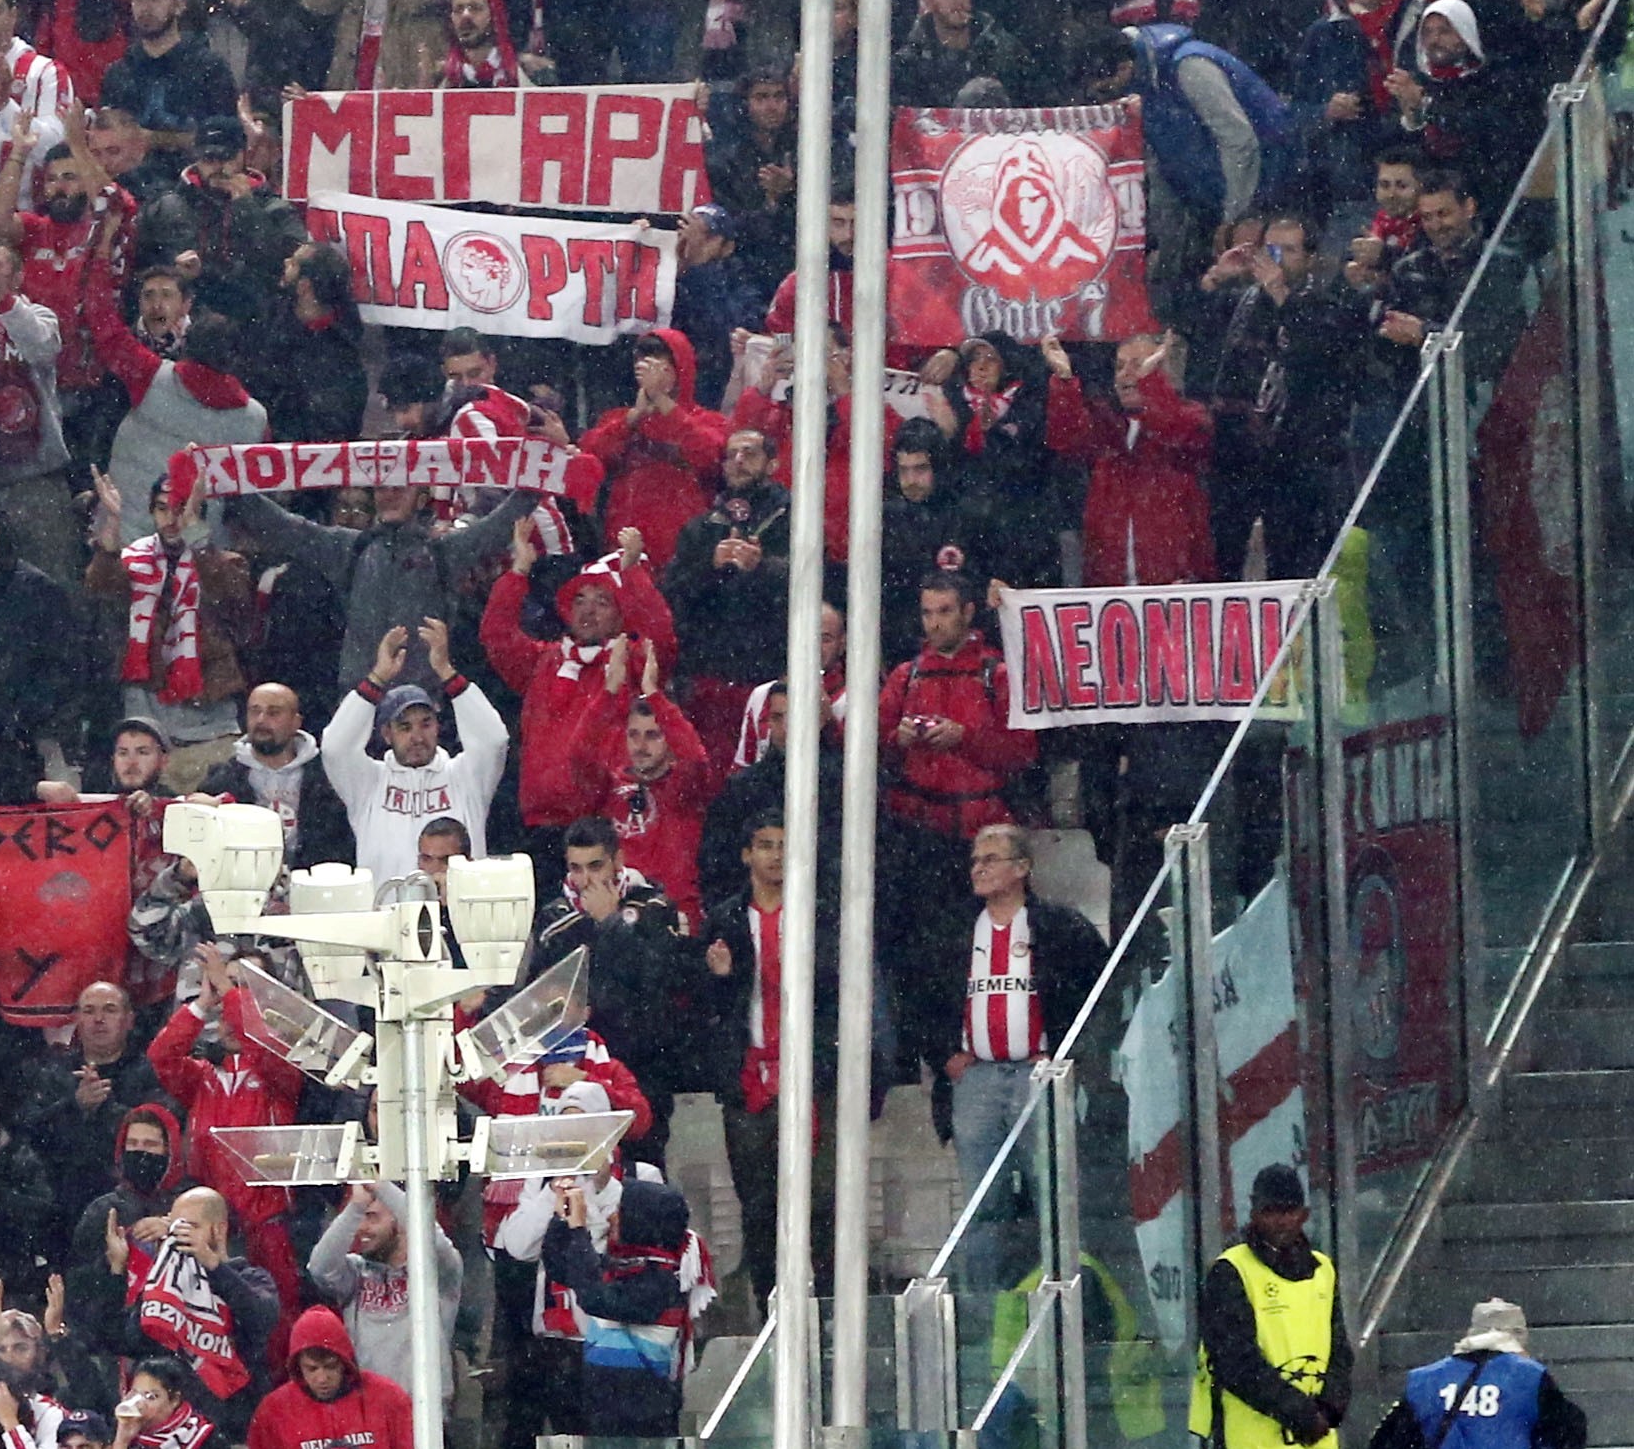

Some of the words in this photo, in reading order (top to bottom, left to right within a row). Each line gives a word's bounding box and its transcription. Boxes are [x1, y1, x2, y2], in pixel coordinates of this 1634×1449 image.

[288, 90, 713, 212] ΜΕΓΑΡΑ
[962, 285, 1063, 339] Gate
[1021, 597, 1295, 714] ΛΕΩΝΙΔΙ
[141, 1299, 188, 1333] razy
[1439, 1383, 1499, 1418] 148
